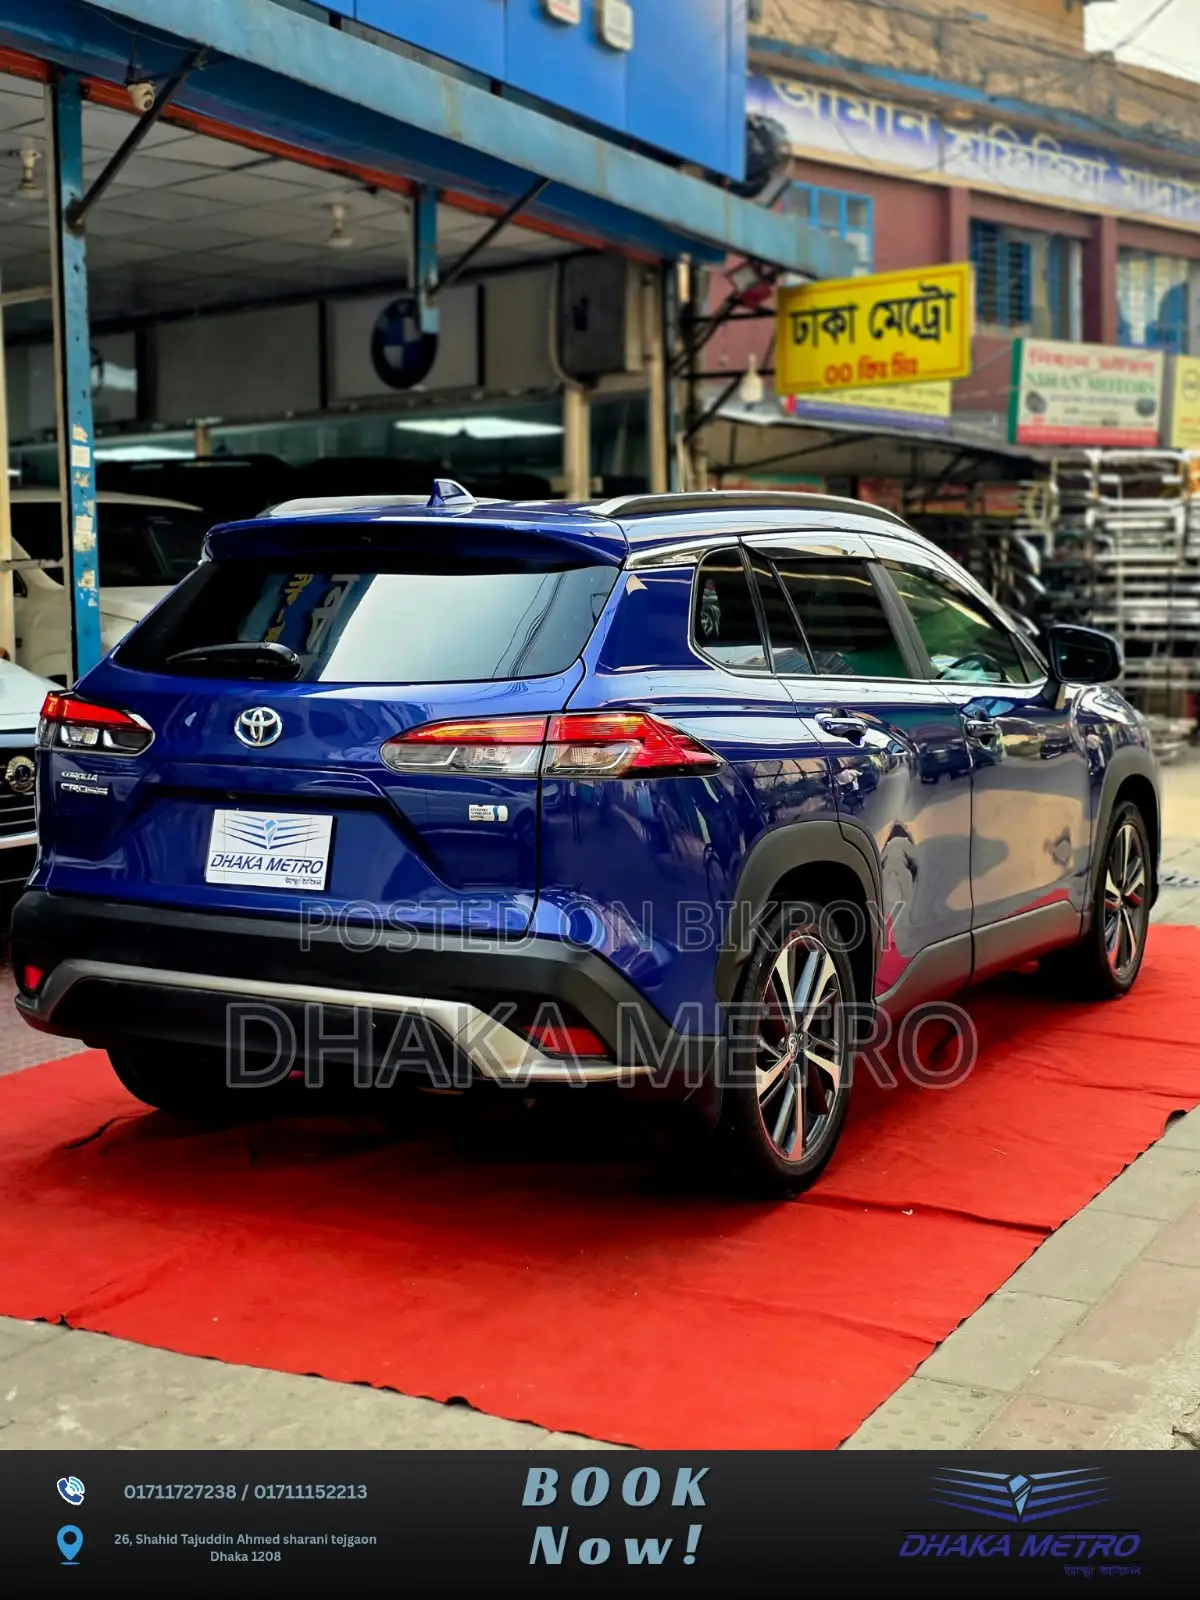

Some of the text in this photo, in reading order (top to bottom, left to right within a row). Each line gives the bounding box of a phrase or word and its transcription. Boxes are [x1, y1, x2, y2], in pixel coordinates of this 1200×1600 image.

[789, 281, 956, 350] ঢাকা মেট্রো
[61, 783, 108, 795] CROSS
[211, 854, 324, 874] DHAKA METRO
